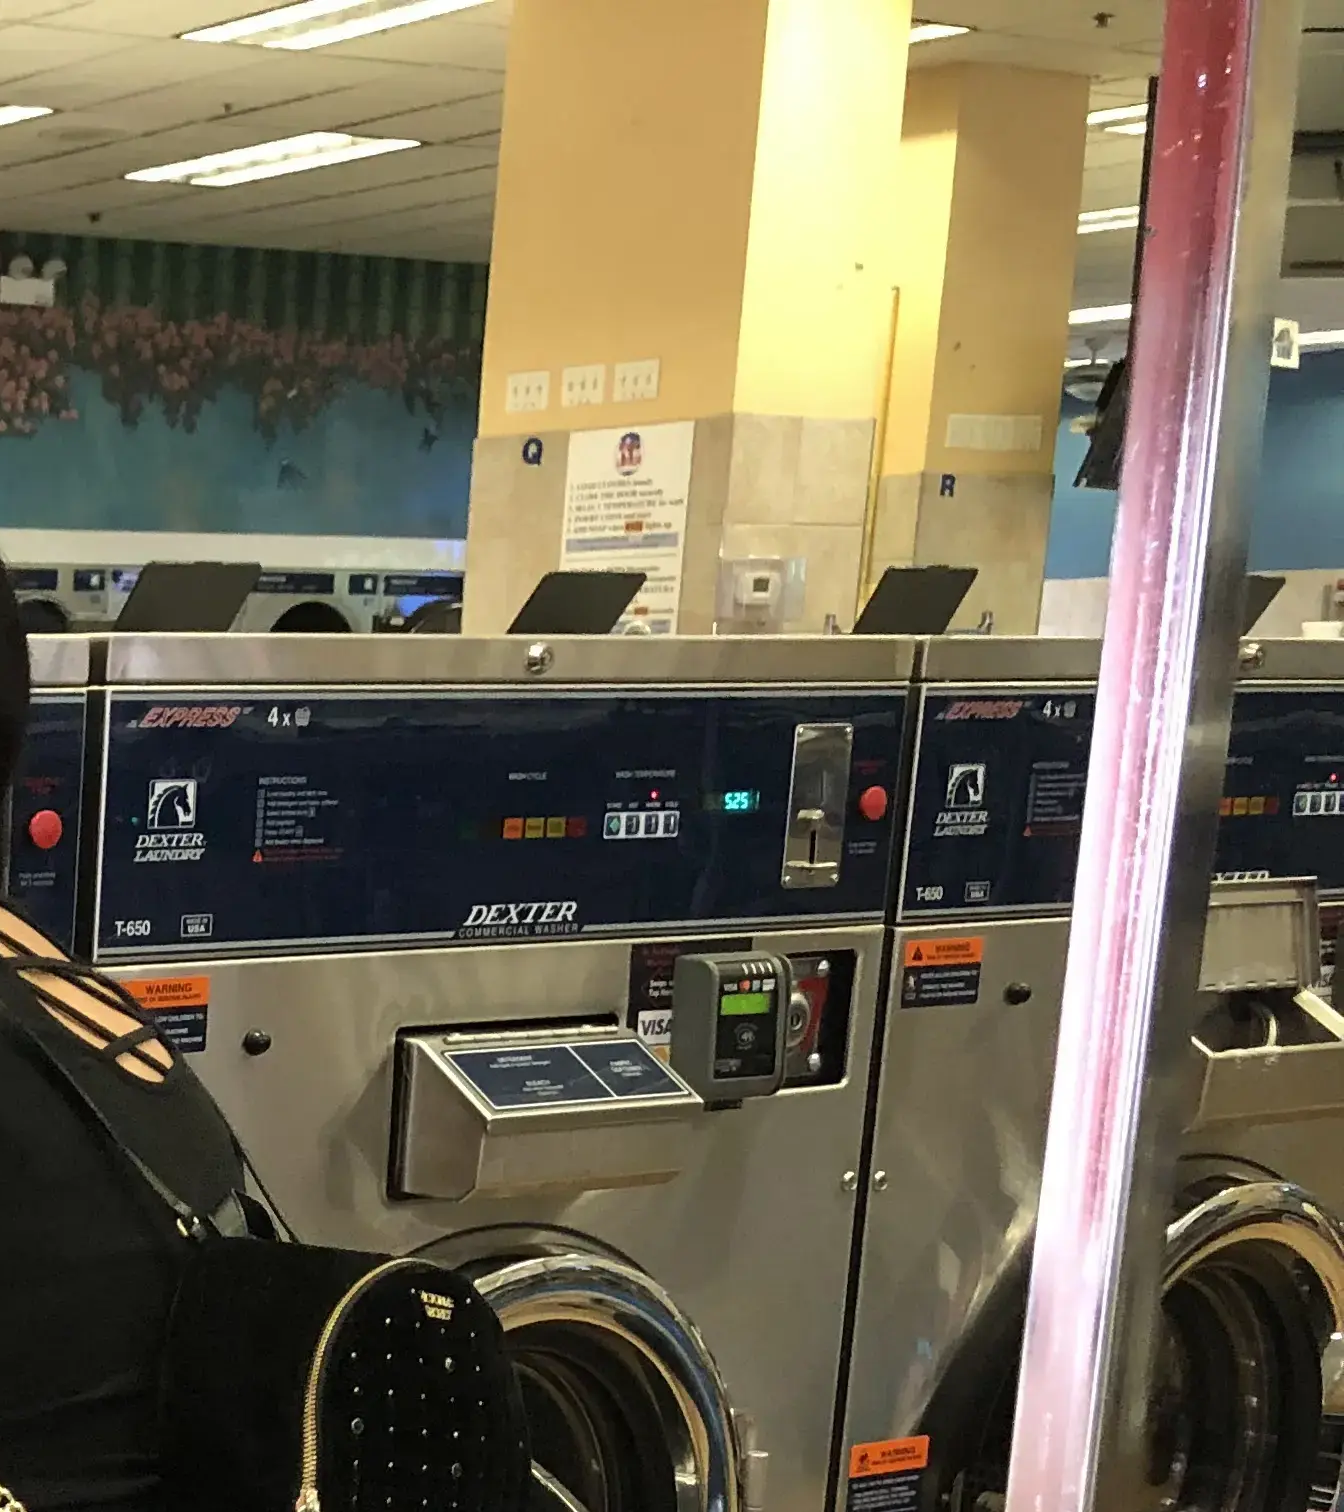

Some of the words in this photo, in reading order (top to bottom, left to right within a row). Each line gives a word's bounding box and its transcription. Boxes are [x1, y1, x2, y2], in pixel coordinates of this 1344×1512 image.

[522, 437, 543, 466] Q
[940, 474, 956, 497] R
[138, 706, 242, 728] EXPRESS
[267, 706, 278, 727] 4
[1042, 700, 1052, 718] 4
[135, 833, 205, 849] DEXTER
[133, 848, 206, 862] LAUNDRY
[463, 901, 577, 926] DEXTER
[115, 920, 151, 937] T-650
[458, 926, 530, 938] COMMERCIAL
[534, 923, 578, 934] WASHER
[145, 983, 193, 995] WARNING
